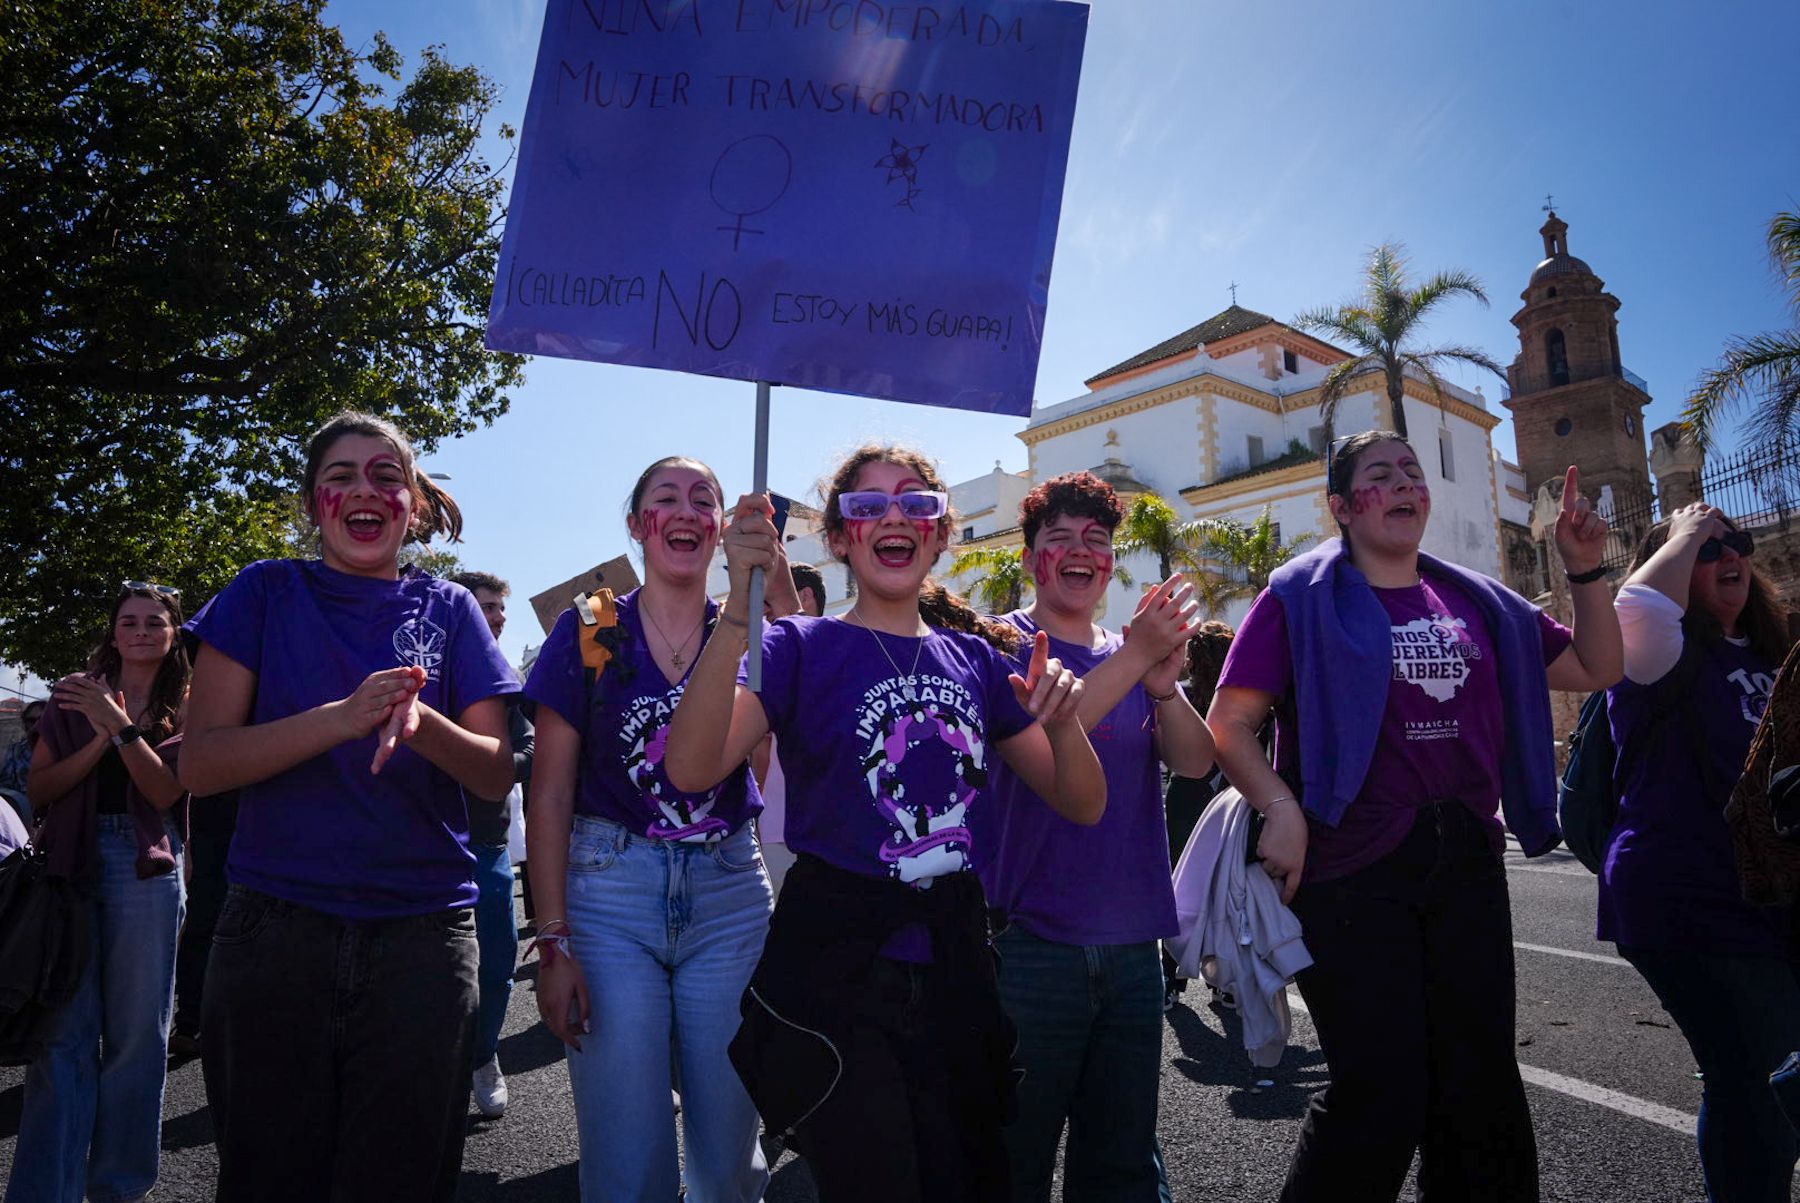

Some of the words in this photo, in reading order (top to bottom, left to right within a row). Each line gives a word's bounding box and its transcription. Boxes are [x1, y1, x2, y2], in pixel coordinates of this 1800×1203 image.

[556, 60, 690, 109] MUJER
[715, 75, 1043, 132] TRANSFORMADORA
[653, 269, 742, 351] NO
[772, 292, 858, 326] ESTOY
[868, 297, 918, 336] MÁS
[926, 308, 1013, 352] GUAPA!
[1392, 632, 1430, 643] NOS
[1394, 662, 1463, 680] LIBRES
[864, 675, 918, 704] JUNTAS
[921, 674, 972, 701] SOMOS
